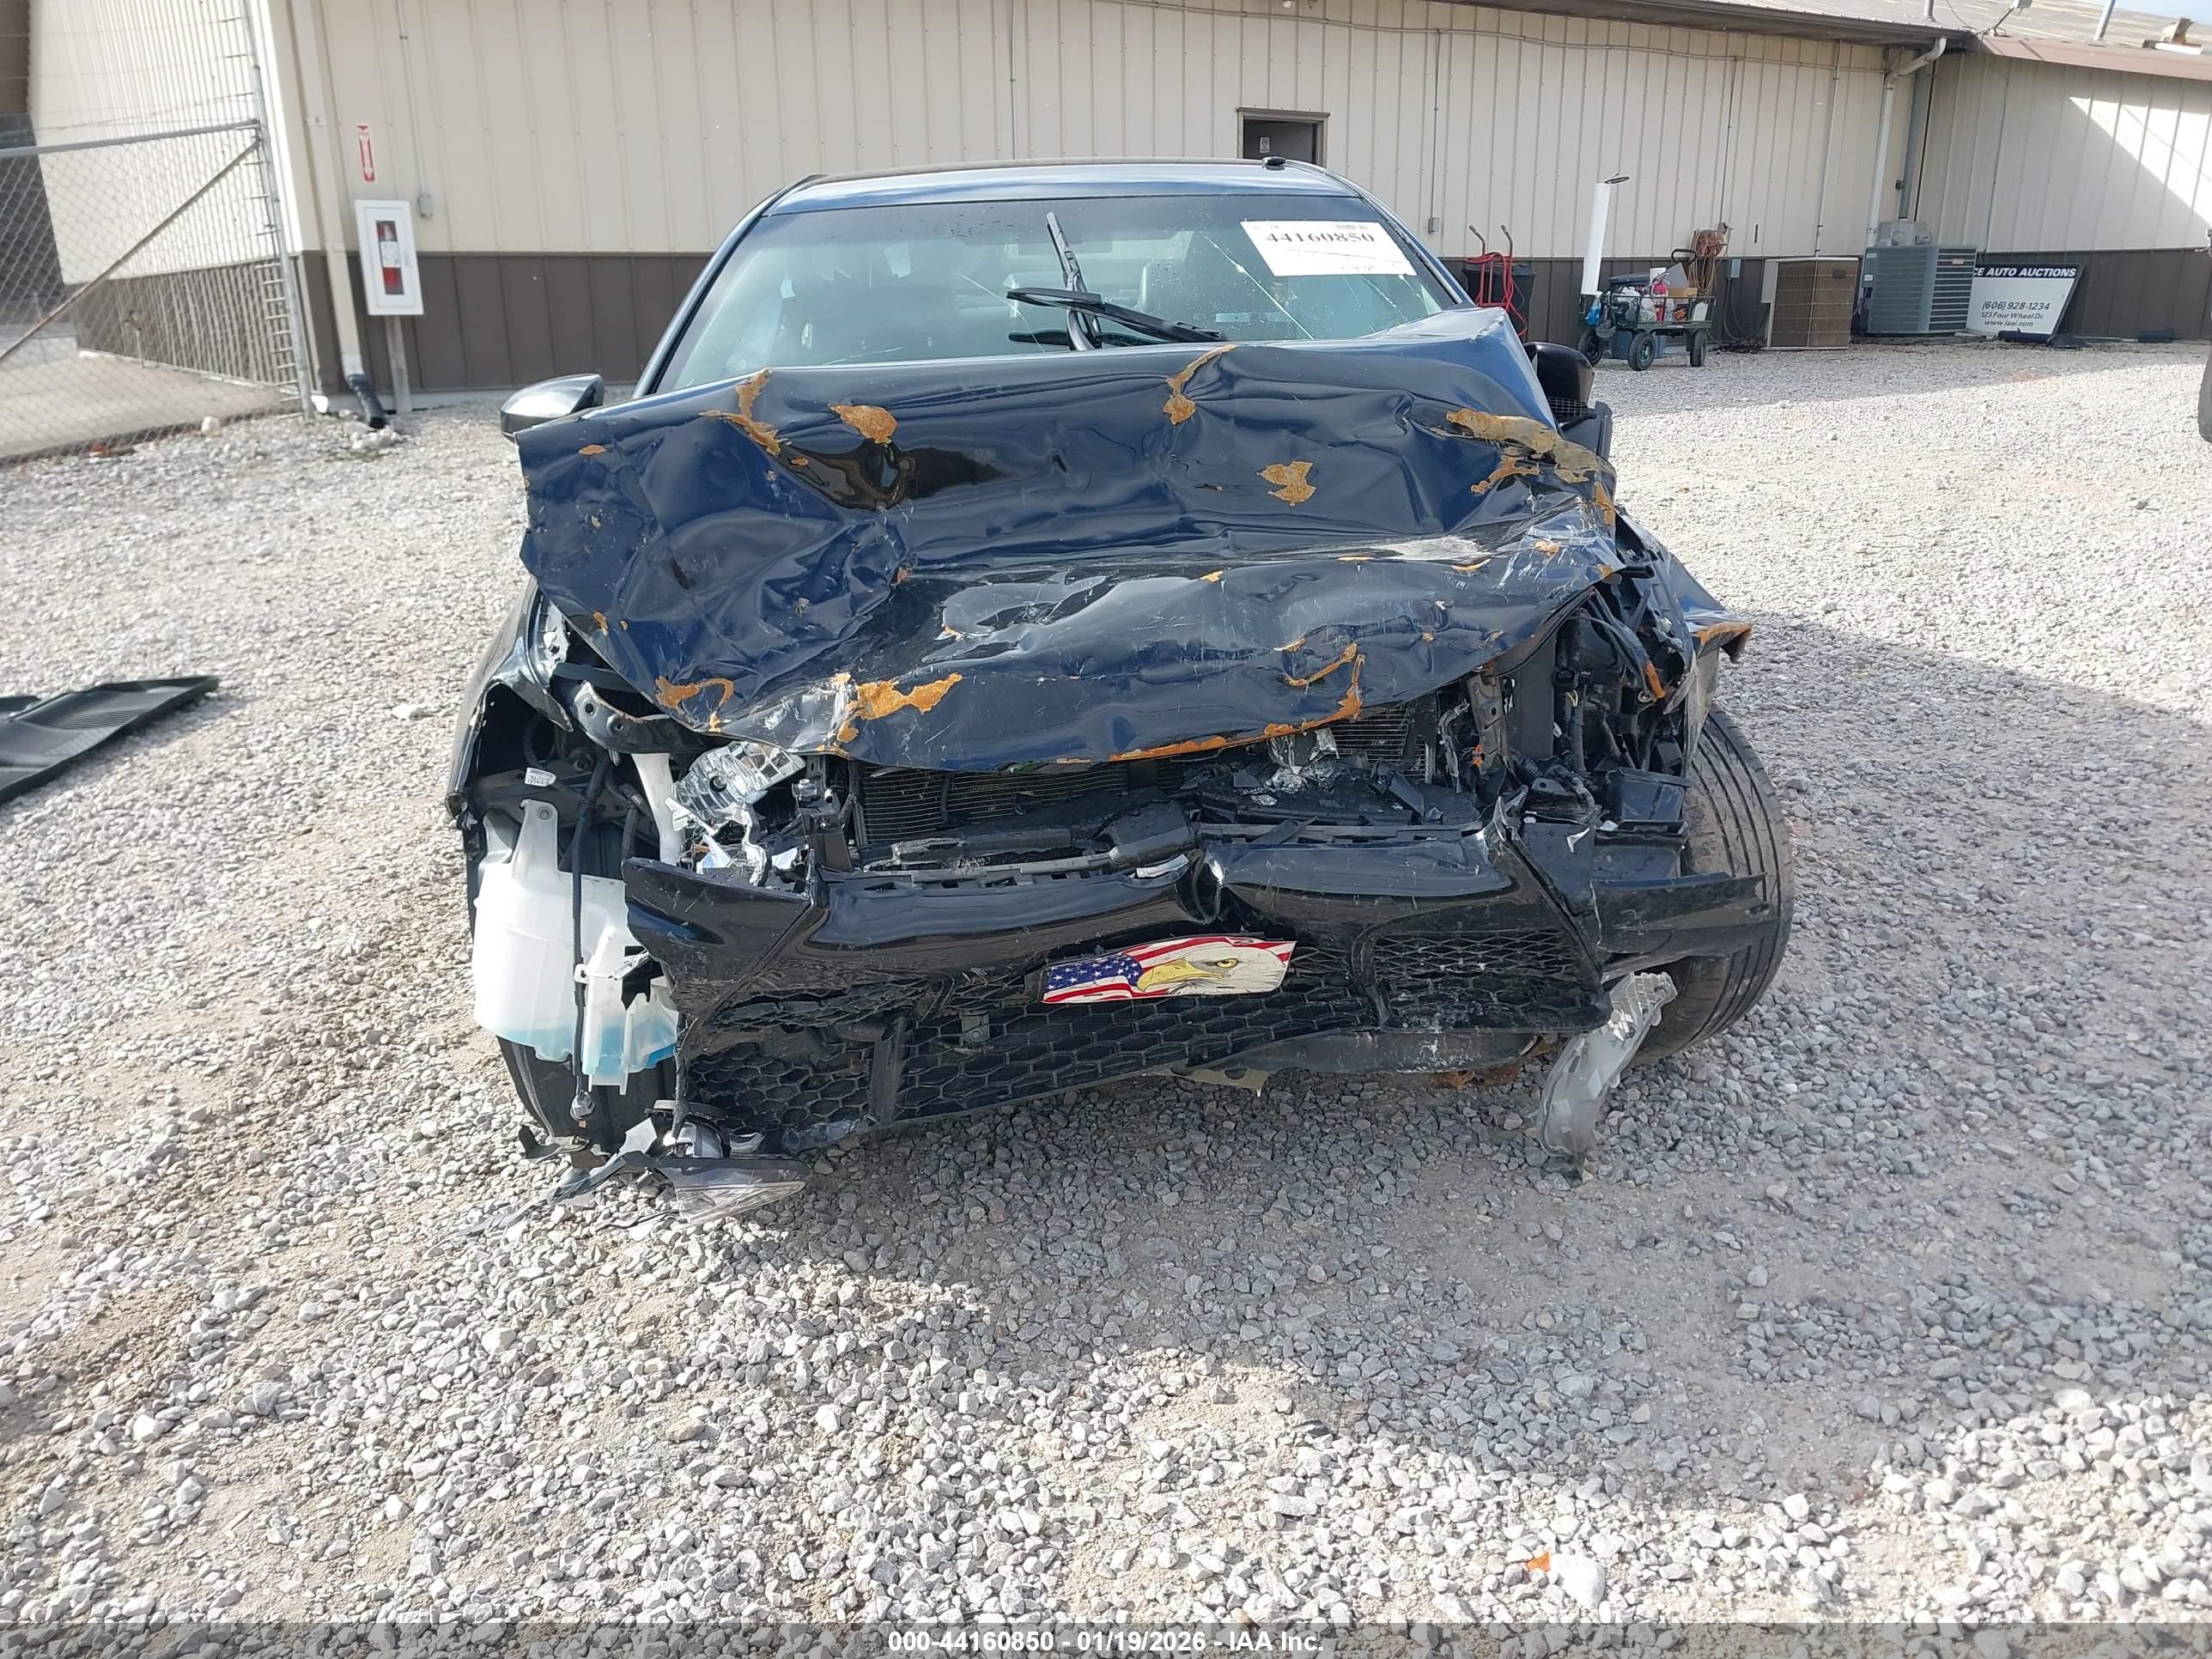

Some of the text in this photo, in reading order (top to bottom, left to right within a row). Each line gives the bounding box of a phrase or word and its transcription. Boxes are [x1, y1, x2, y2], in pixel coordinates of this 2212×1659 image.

[1267, 233, 1376, 243] 44160850
[1985, 267, 2017, 276] AUTO
[2019, 268, 2077, 277] AUCTIONS
[1982, 301, 2051, 311] (606) 928-1234
